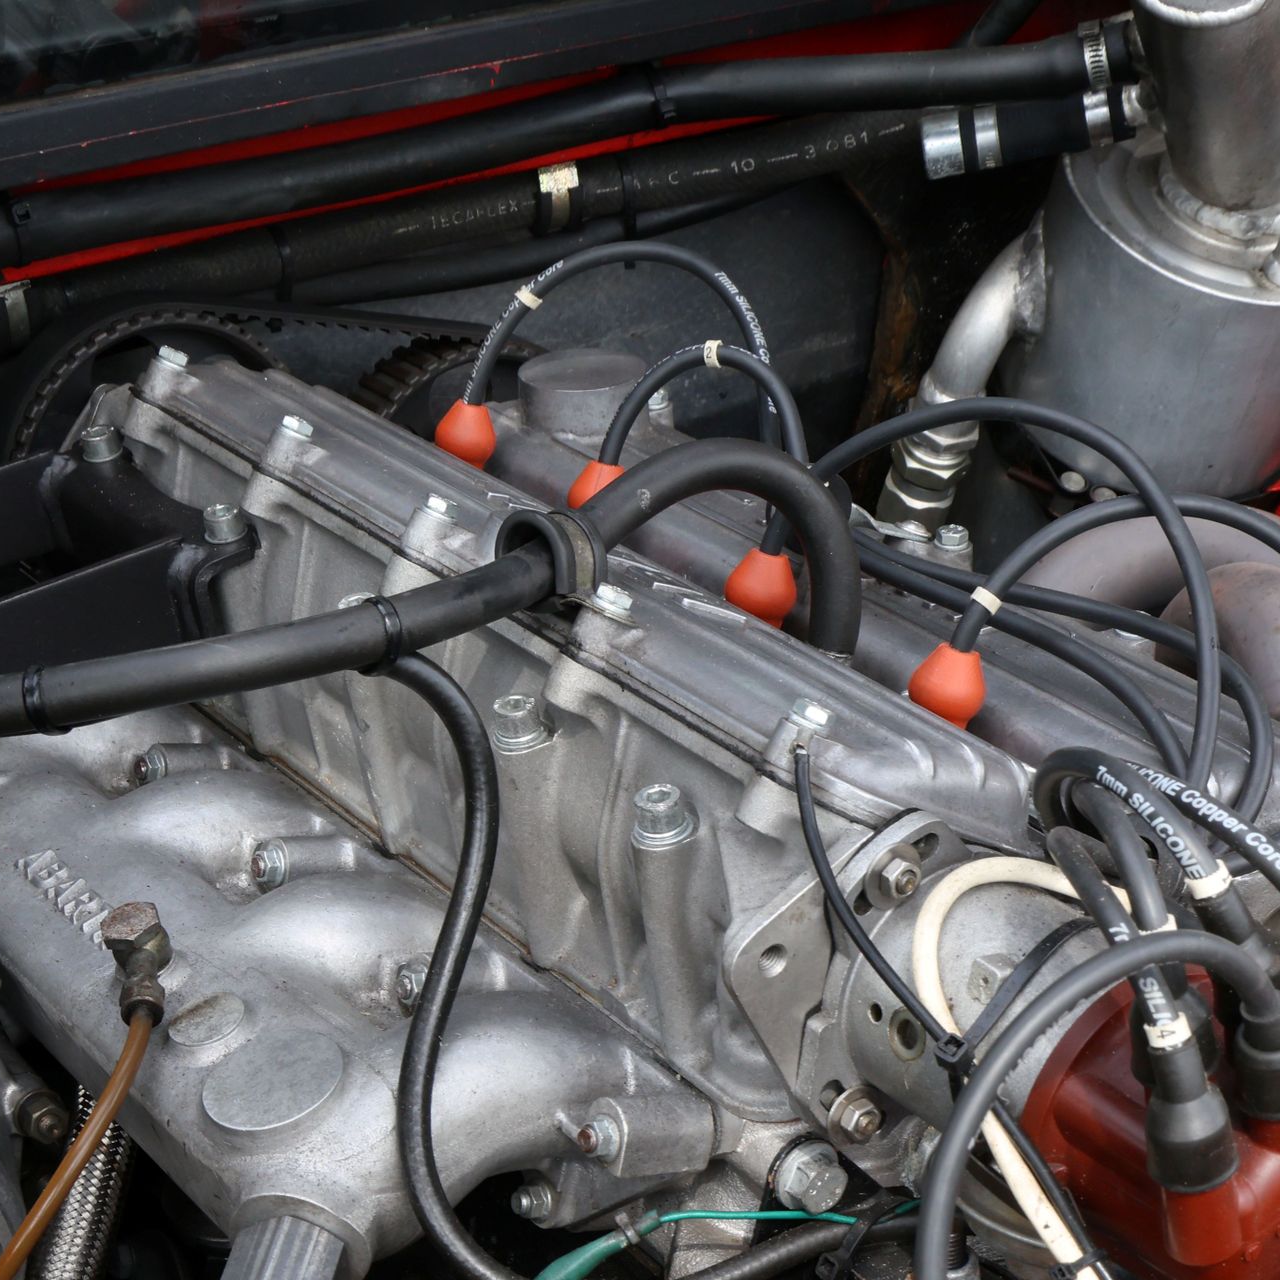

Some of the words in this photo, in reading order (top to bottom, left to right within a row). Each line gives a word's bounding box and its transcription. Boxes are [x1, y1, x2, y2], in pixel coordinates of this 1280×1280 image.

[731, 158, 756, 175] 10
[537, 258, 565, 282] Core
[714, 270, 739, 295] 7mm
[735, 294, 769, 349] SILICONE
[705, 346, 713, 359] 2
[1095, 764, 1128, 798] 7mm
[1128, 792, 1207, 879] SILICONE
[1181, 788, 1249, 835] Copper
[1156, 1027, 1176, 1039] 4
